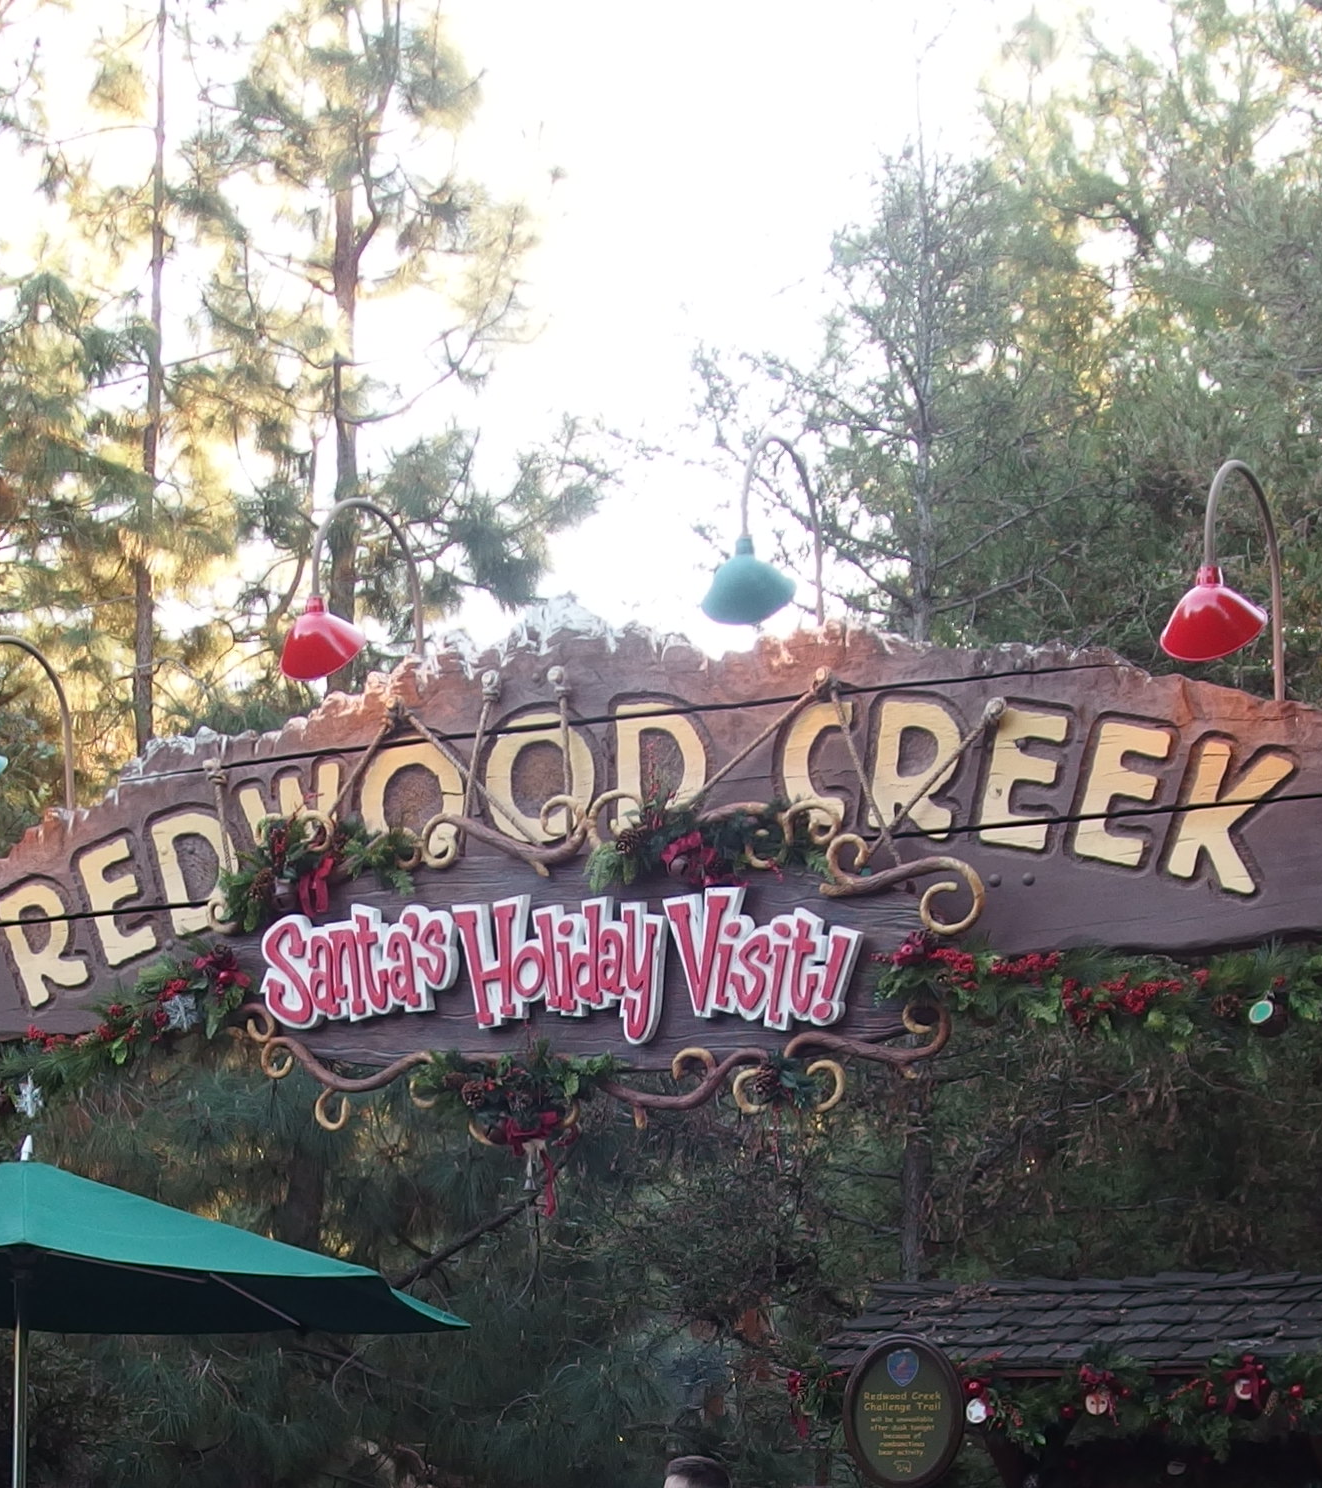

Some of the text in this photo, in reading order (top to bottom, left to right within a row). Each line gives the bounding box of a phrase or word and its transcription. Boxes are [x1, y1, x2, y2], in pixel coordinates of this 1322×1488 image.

[780, 699, 1297, 895] CREEK
[261, 887, 864, 1045] Santa's Holiday Visit!
[863, 1391, 941, 1400] Redwood Creek
[863, 1401, 941, 1413] Challenge Trail
